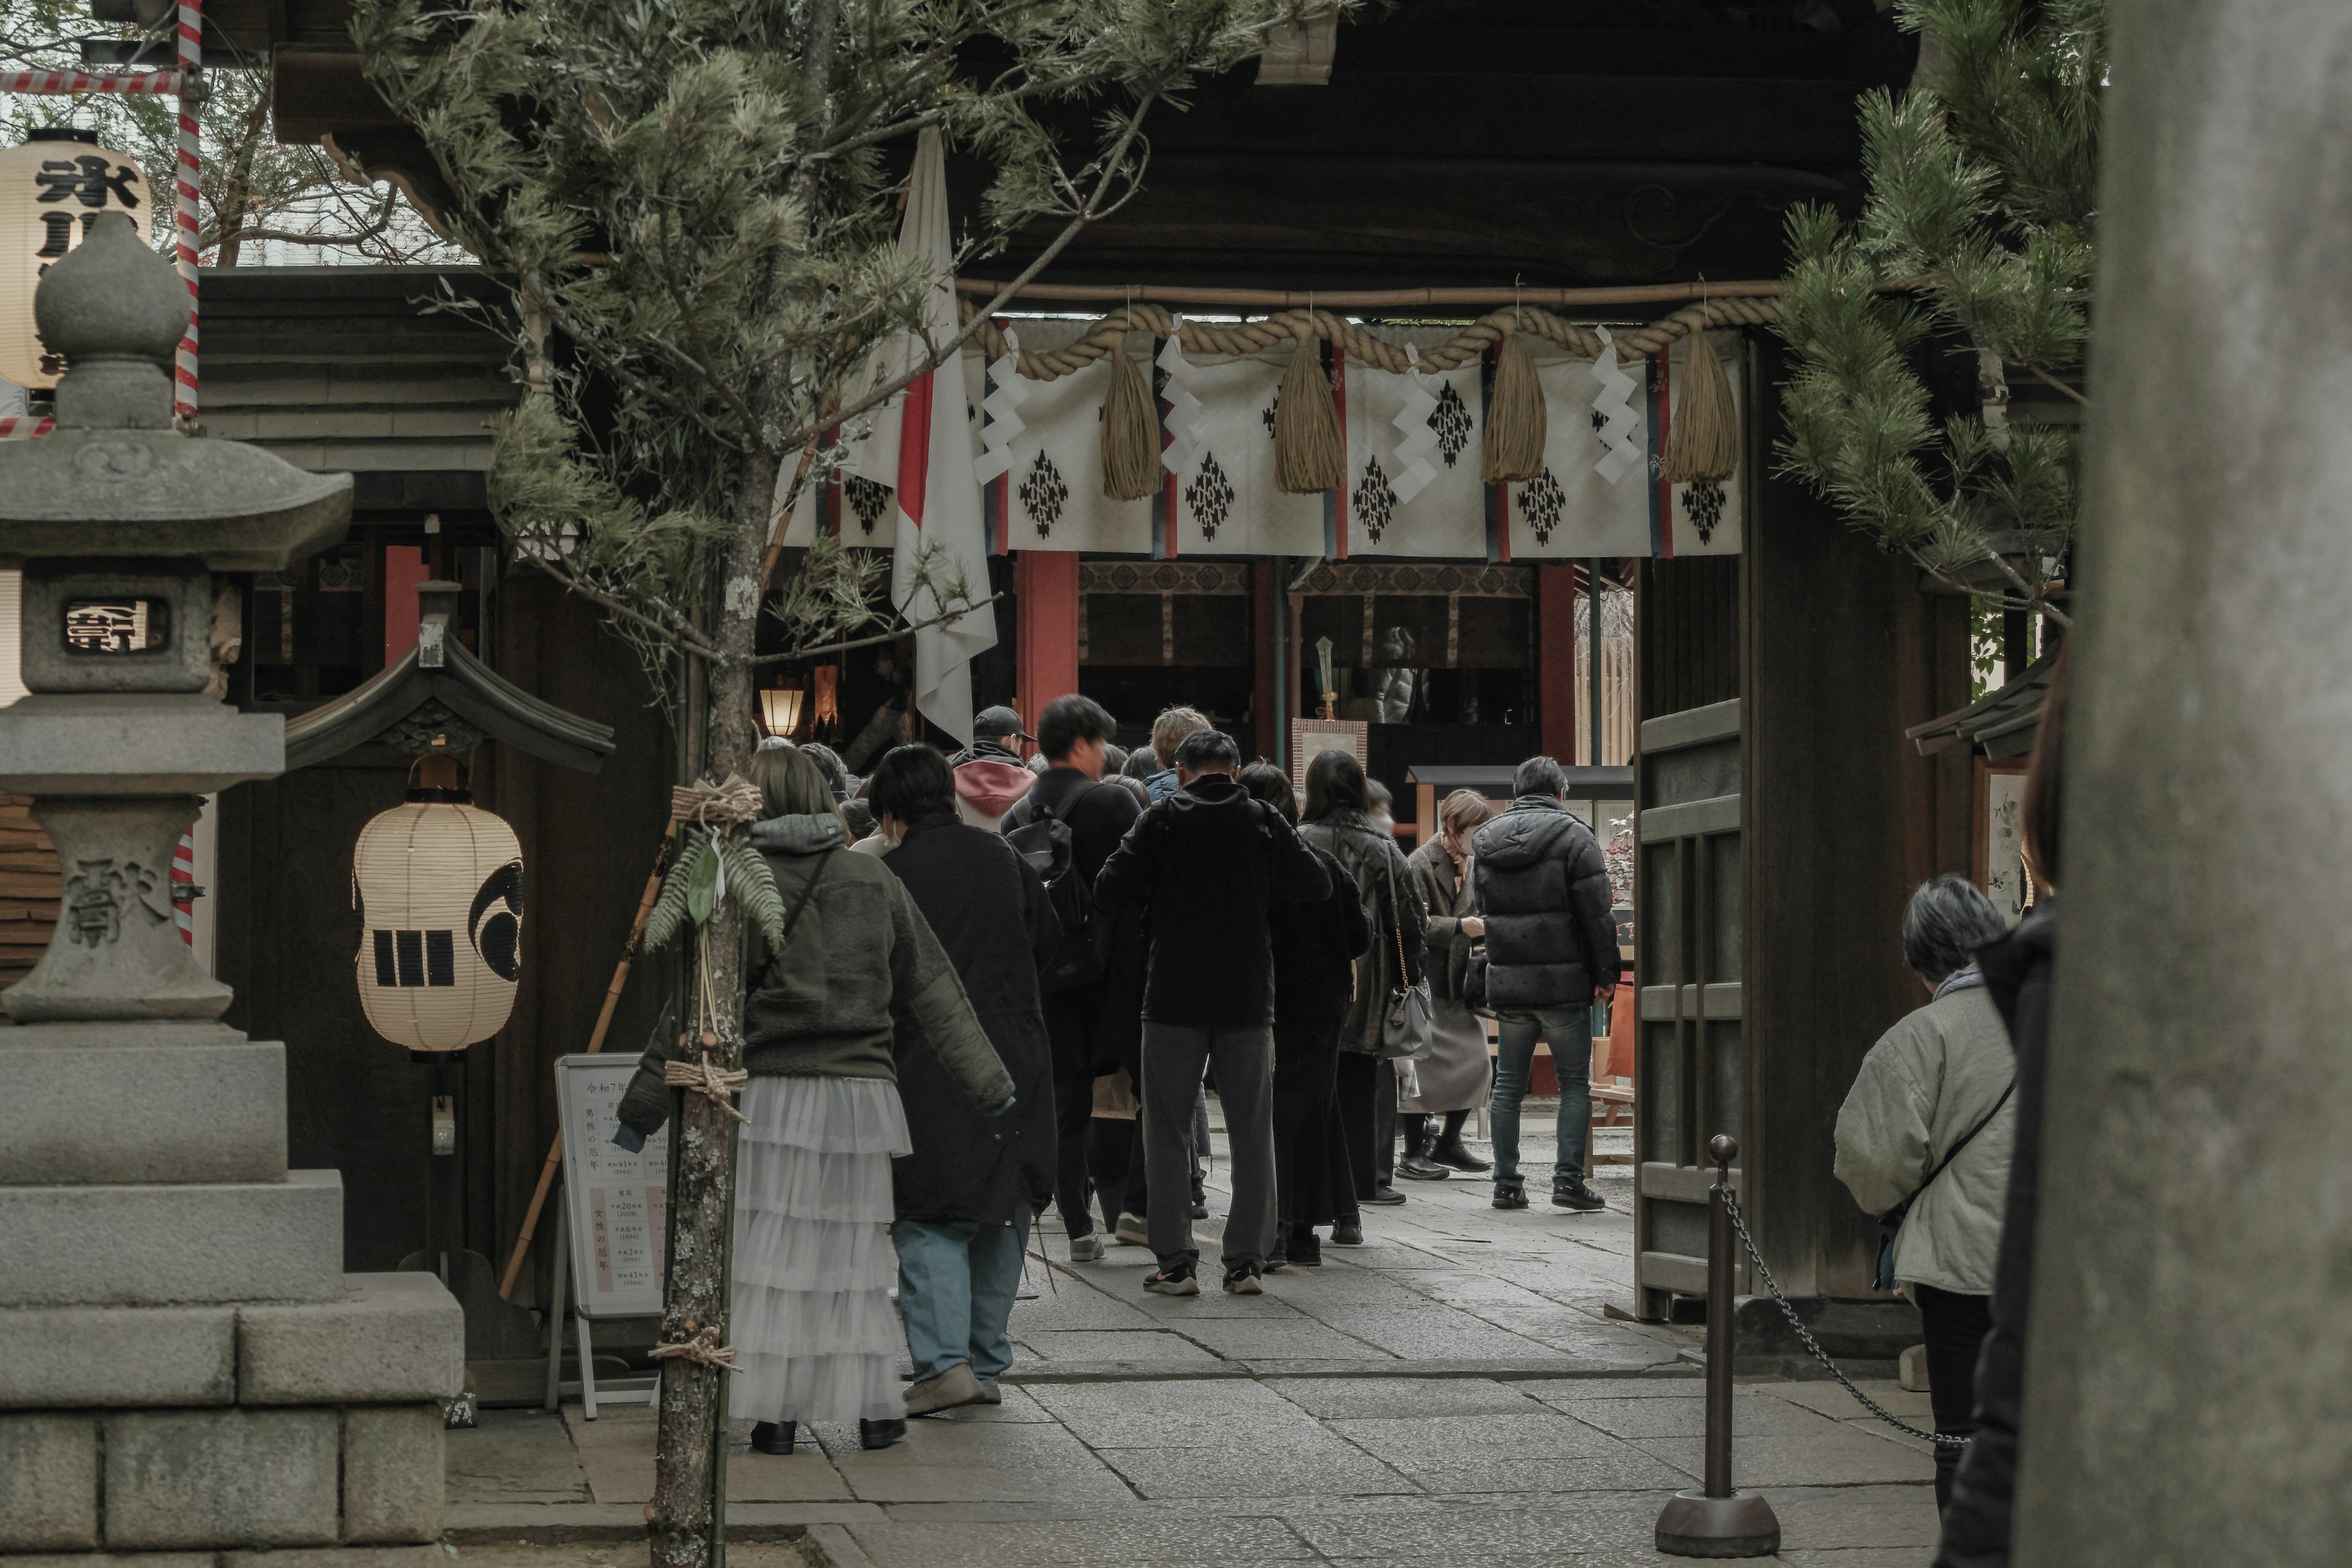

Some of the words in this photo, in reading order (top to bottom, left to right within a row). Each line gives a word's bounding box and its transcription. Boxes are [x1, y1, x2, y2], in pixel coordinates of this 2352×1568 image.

[586, 1109, 598, 1170] 男性の厄年
[595, 1209, 608, 1270] 女性の厄年
